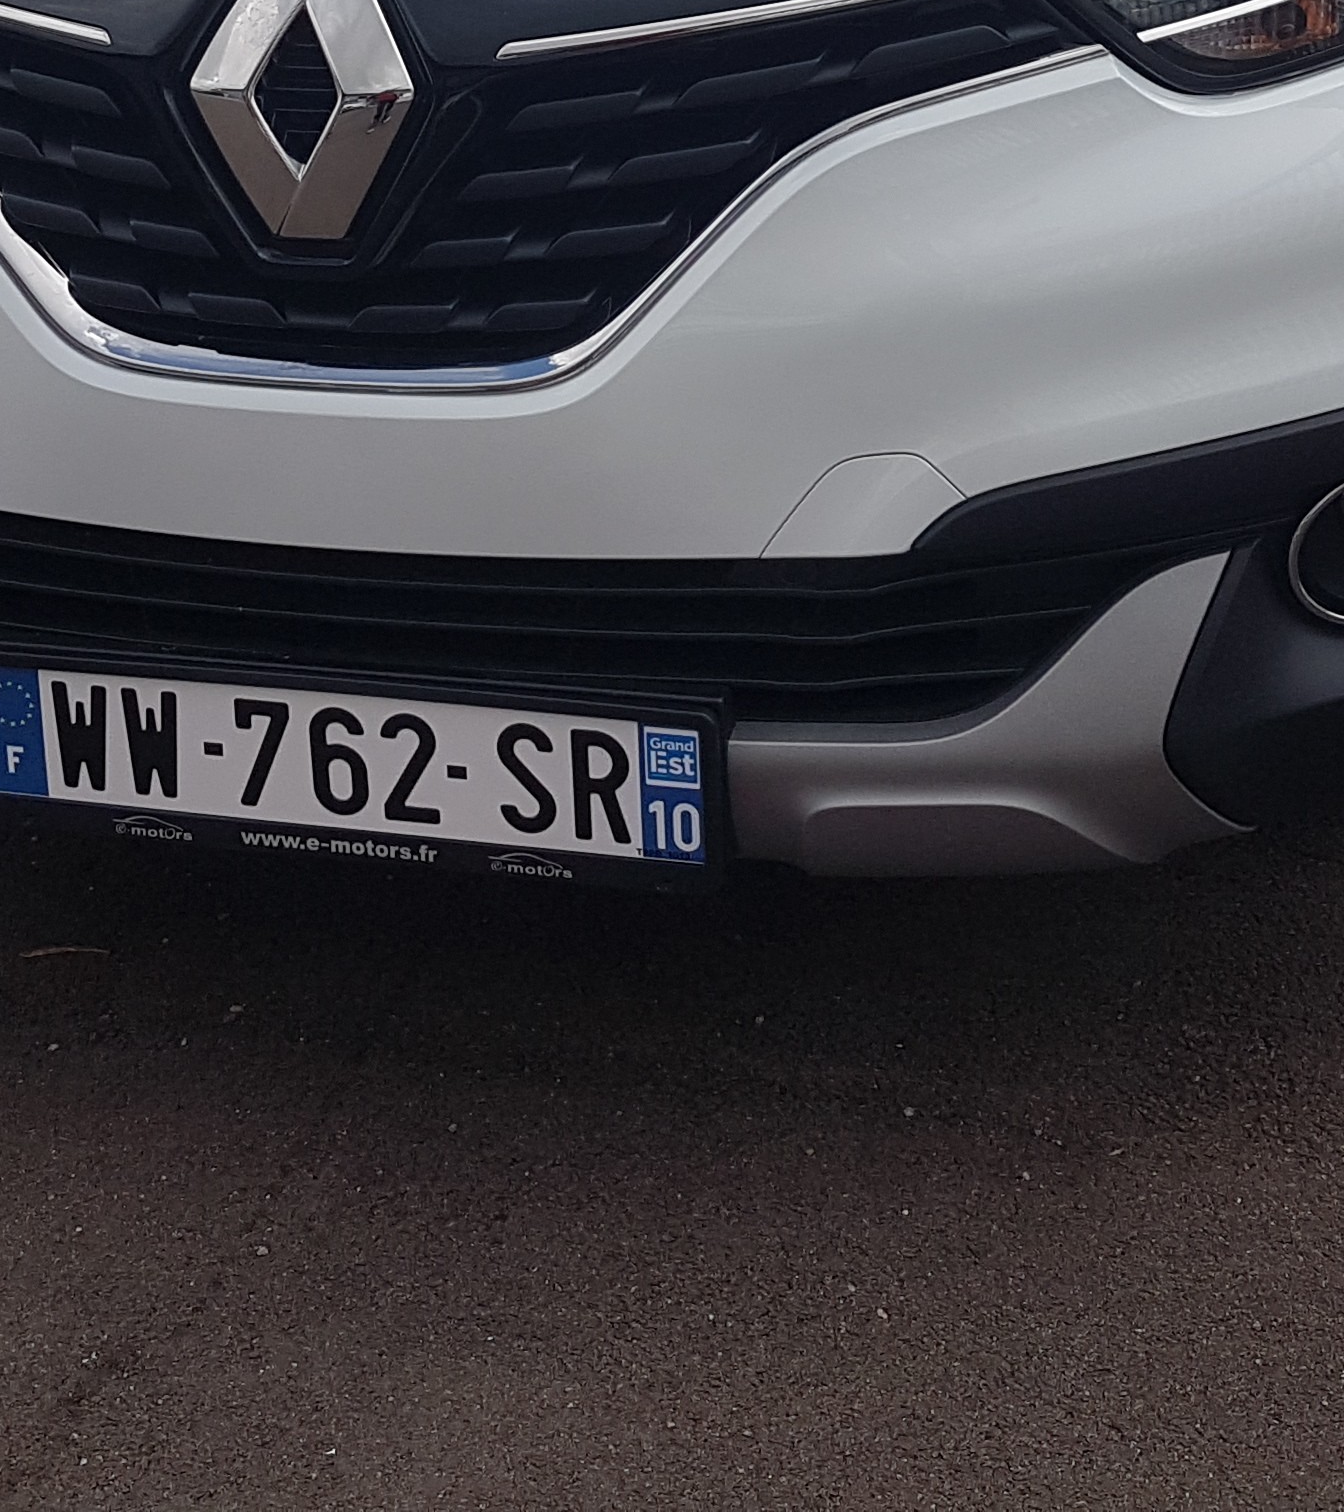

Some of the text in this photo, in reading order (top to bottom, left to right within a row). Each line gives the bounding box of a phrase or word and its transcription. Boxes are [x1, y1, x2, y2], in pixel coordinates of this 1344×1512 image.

[6, 744, 25, 774] F
[649, 736, 695, 753] Grand
[51, 679, 634, 845] WW-762-SR
[649, 750, 696, 777] Est
[648, 799, 702, 853] 10
[240, 831, 438, 863] www.e-motors.fr
